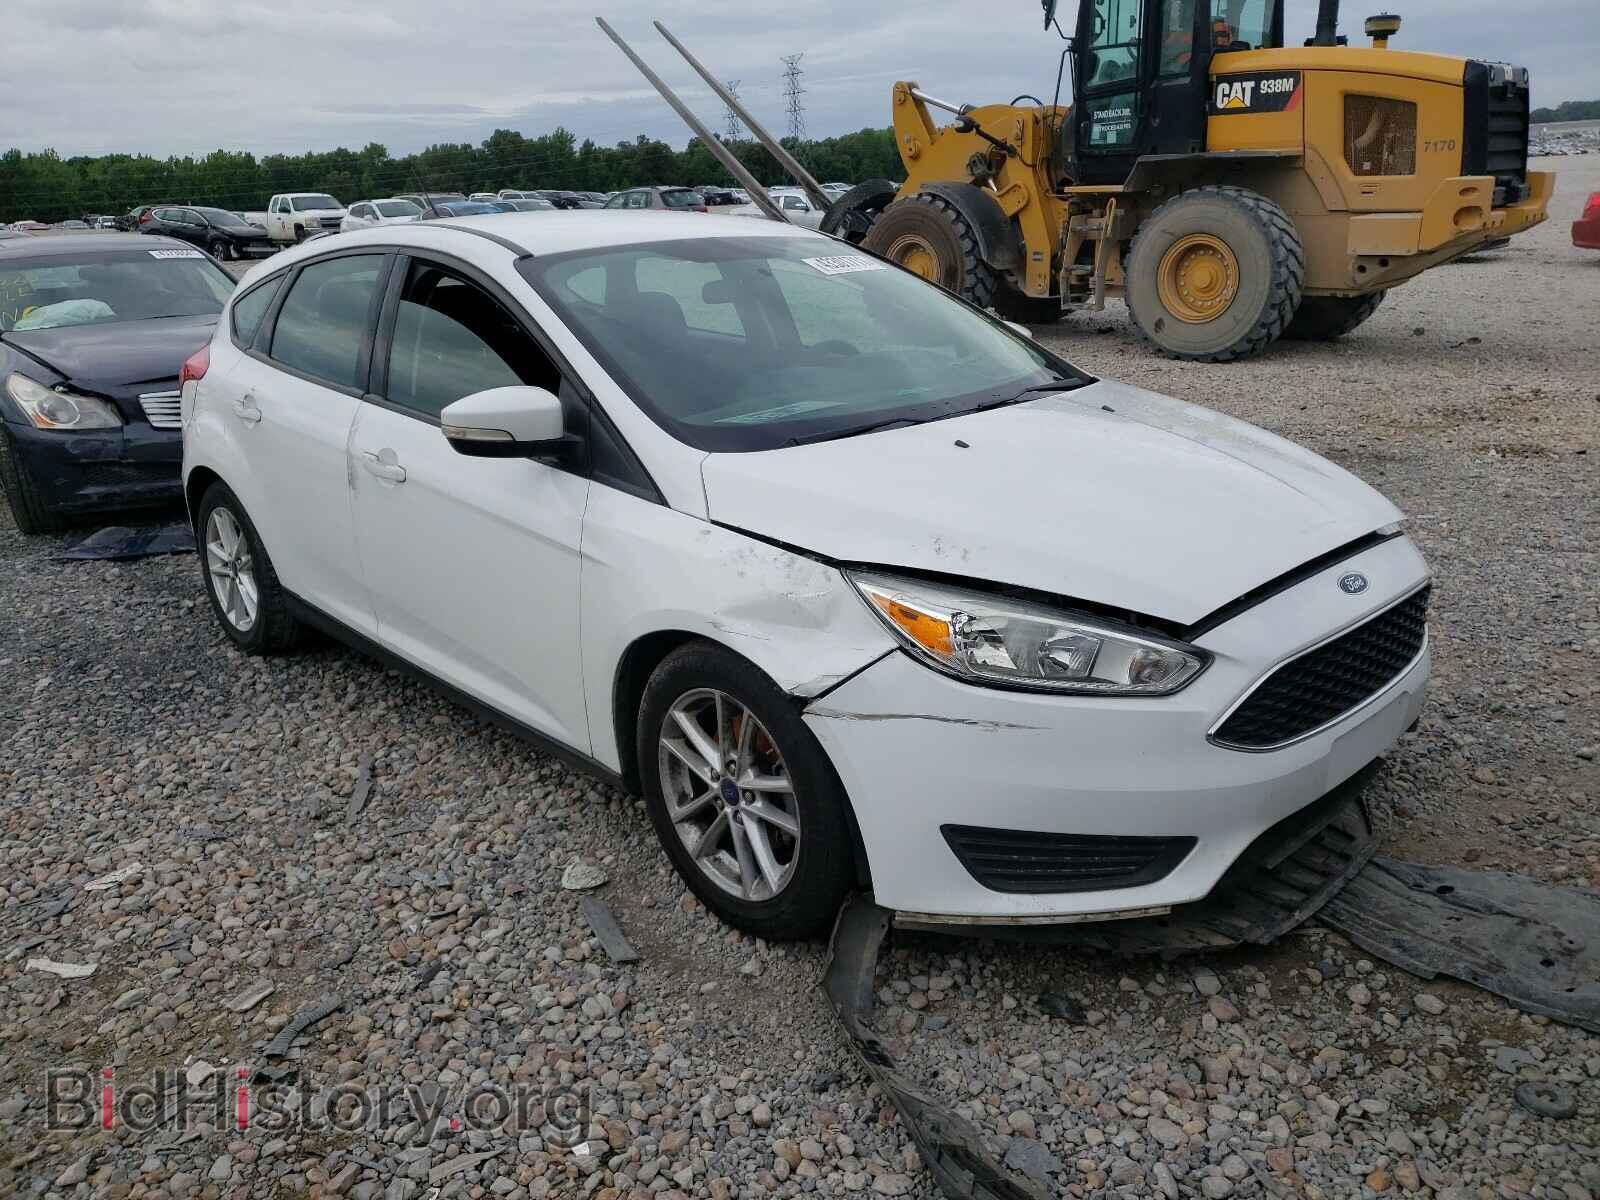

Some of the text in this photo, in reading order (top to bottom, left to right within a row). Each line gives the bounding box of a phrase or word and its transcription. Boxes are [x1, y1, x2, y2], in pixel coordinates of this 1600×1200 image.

[1216, 78, 1294, 109] CAT 938M
[1423, 139, 1456, 153] 7170
[1345, 576, 1365, 591] Ford
